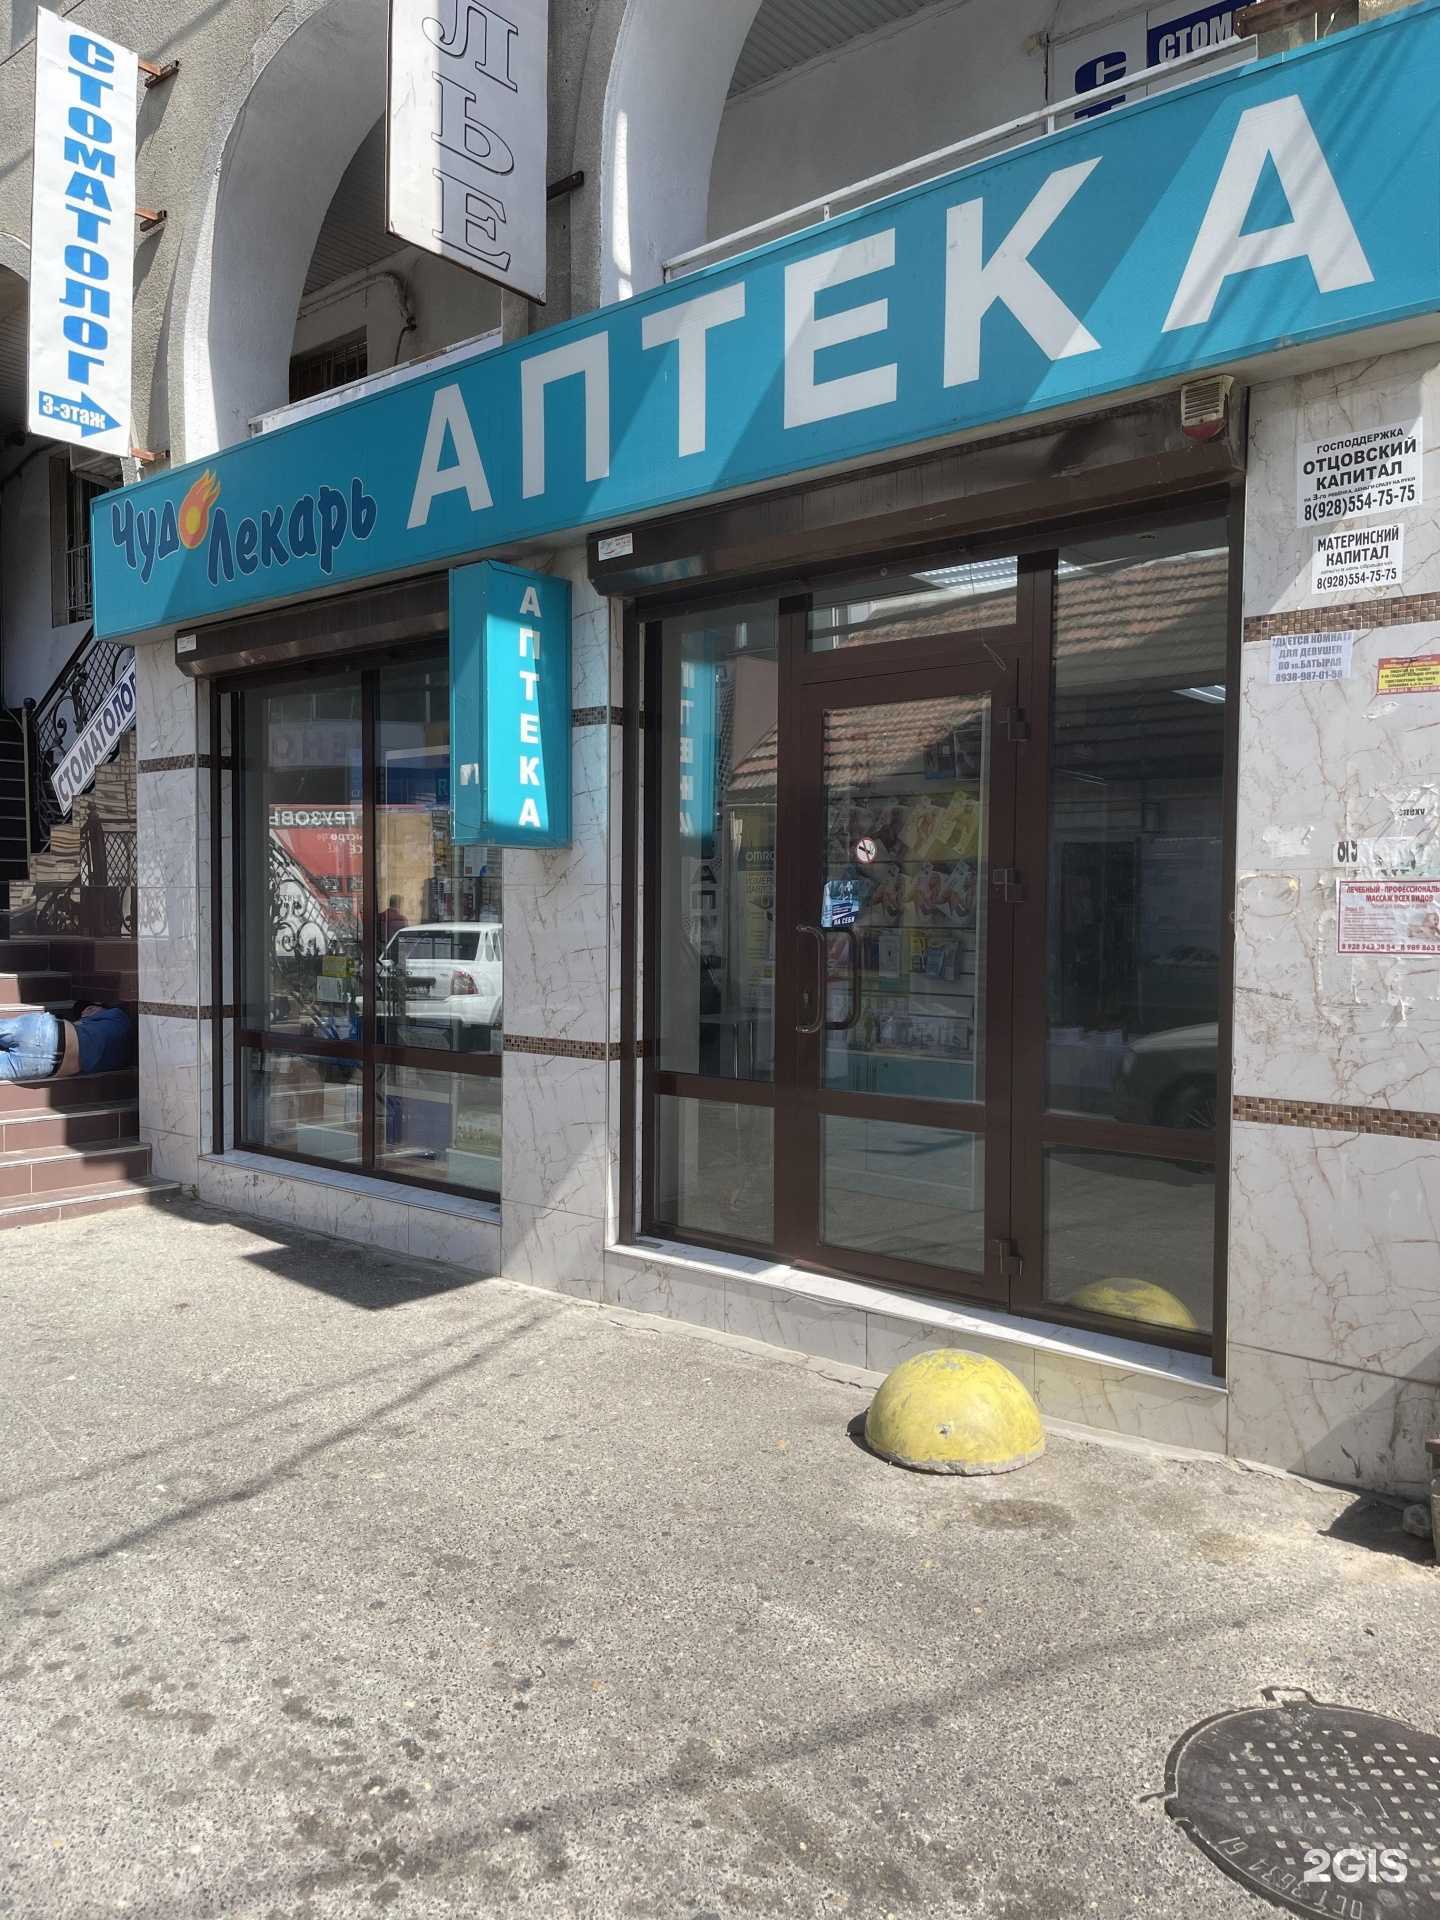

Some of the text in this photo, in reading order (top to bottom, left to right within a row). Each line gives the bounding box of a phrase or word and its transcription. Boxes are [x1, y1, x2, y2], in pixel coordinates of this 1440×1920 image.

[59, 33, 116, 386] СТОМАТОЛОГ
[407, 94, 1375, 529] АПТЕКА
[42, 394, 107, 430] 3-этаж
[1302, 436, 1417, 475] ОТЦОВСКИЙ
[1316, 428, 1404, 454] ГОСПОДДЕРЖКА
[1316, 460, 1403, 491] КАПИТАЛ
[1304, 484, 1416, 521] 8(928)554-75-75
[1317, 526, 1399, 553] МАТЕРИНСКИЙ
[1326, 545, 1389, 567] КАПИТАЛ
[1316, 567, 1397, 590] 8(928)554-75-75
[518, 585, 543, 828] АПТЕКА
